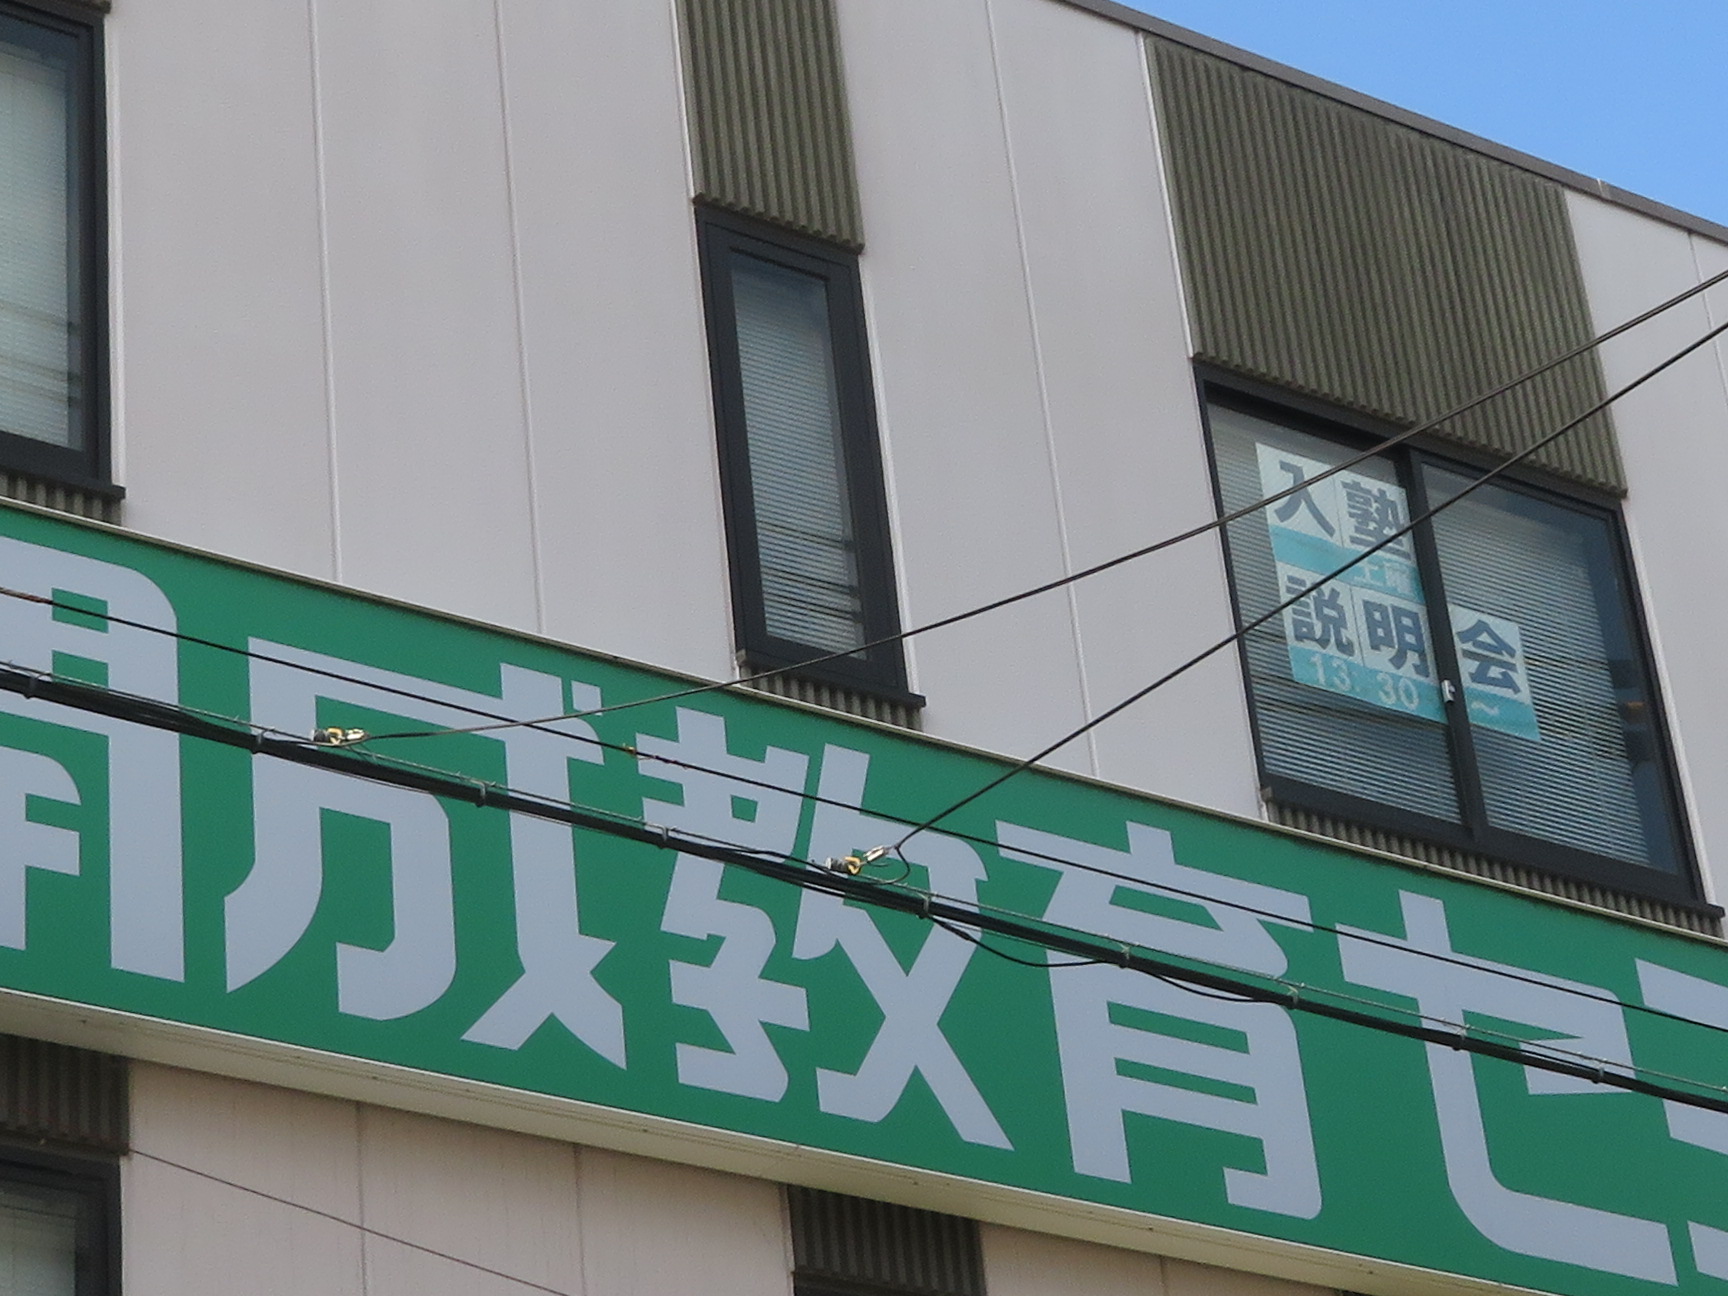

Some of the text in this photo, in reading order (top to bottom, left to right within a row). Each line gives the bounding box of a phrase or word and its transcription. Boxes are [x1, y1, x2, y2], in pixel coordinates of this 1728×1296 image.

[1274, 460, 1412, 561] 入塾
[1286, 575, 1521, 695] 説明会
